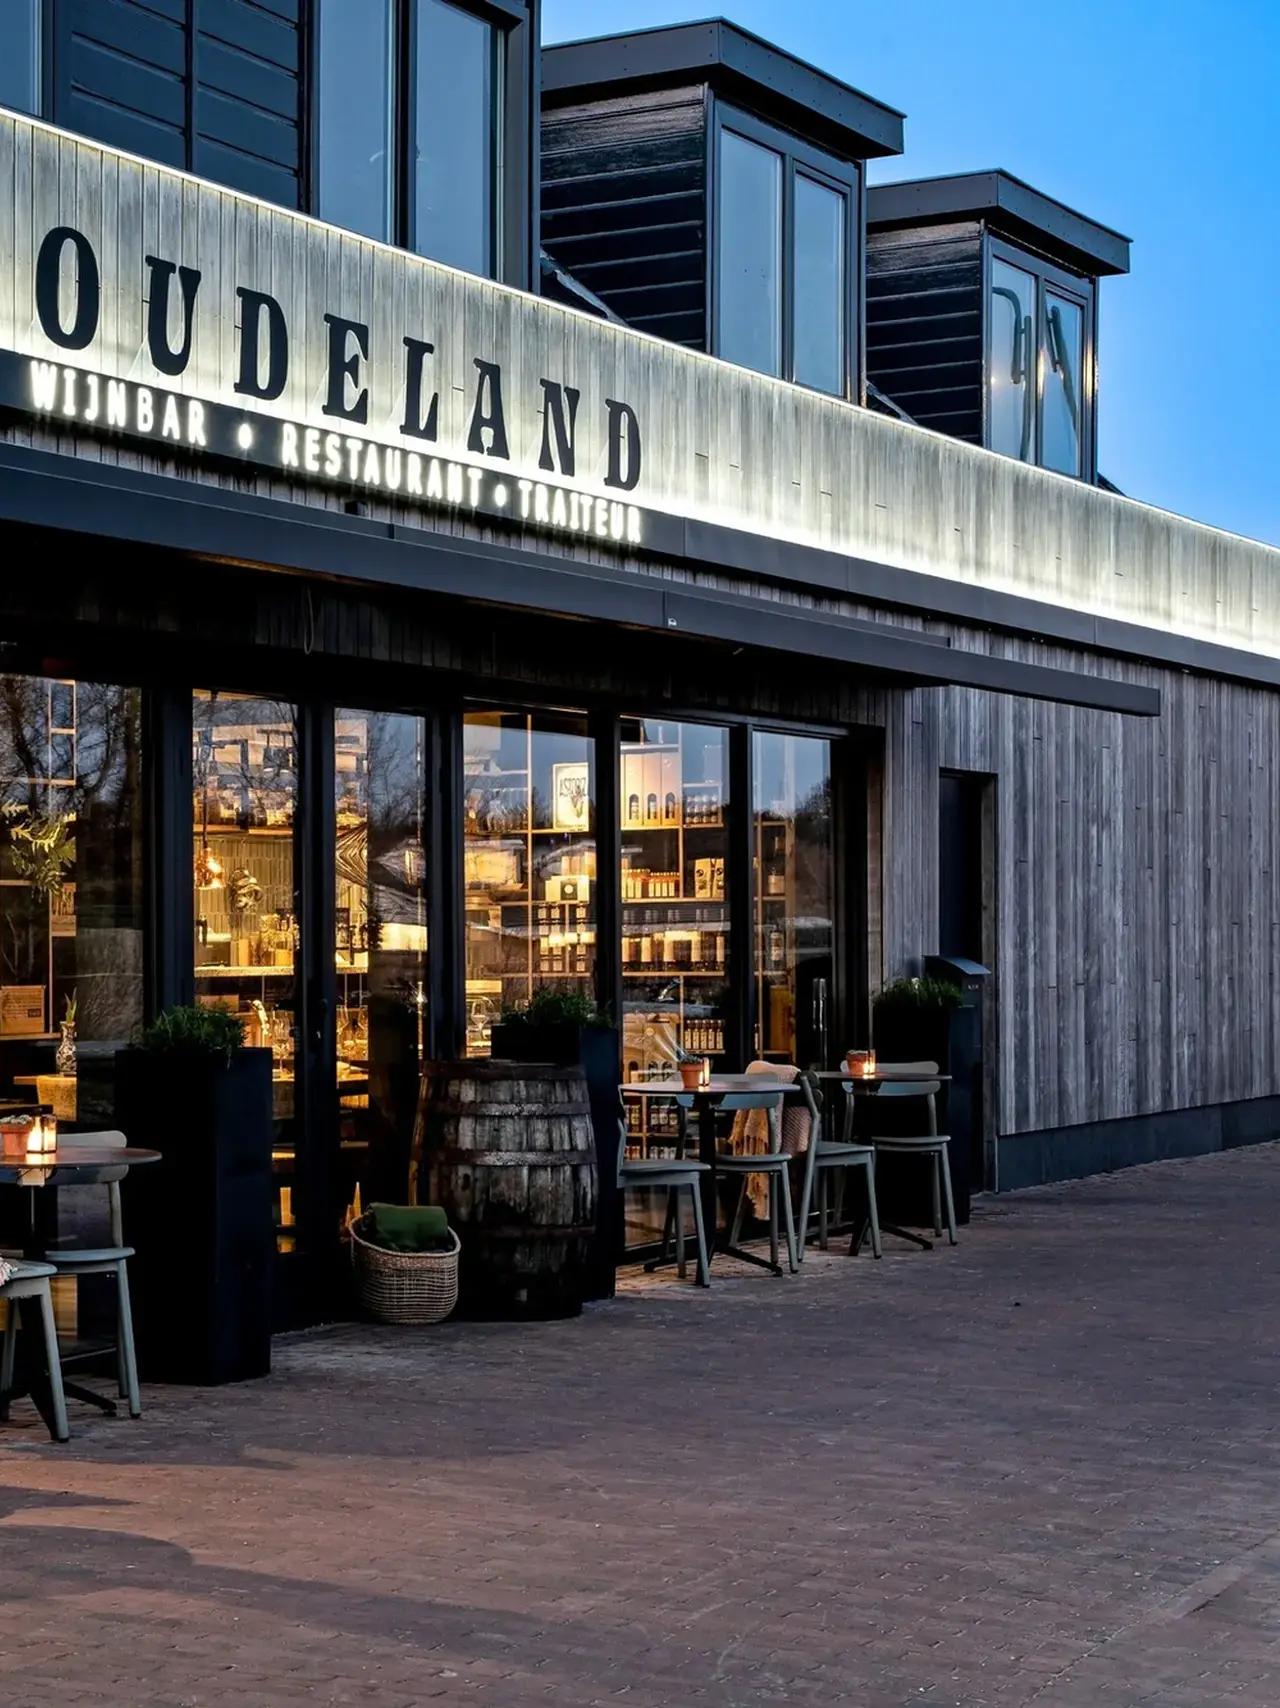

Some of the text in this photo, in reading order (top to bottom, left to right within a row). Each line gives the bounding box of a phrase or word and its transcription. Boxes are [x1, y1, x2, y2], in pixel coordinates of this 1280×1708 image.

[30, 360, 641, 543] WIJNBAR RESTAURANT TRAITEUR
[36, 227, 641, 491] OUDELAND
